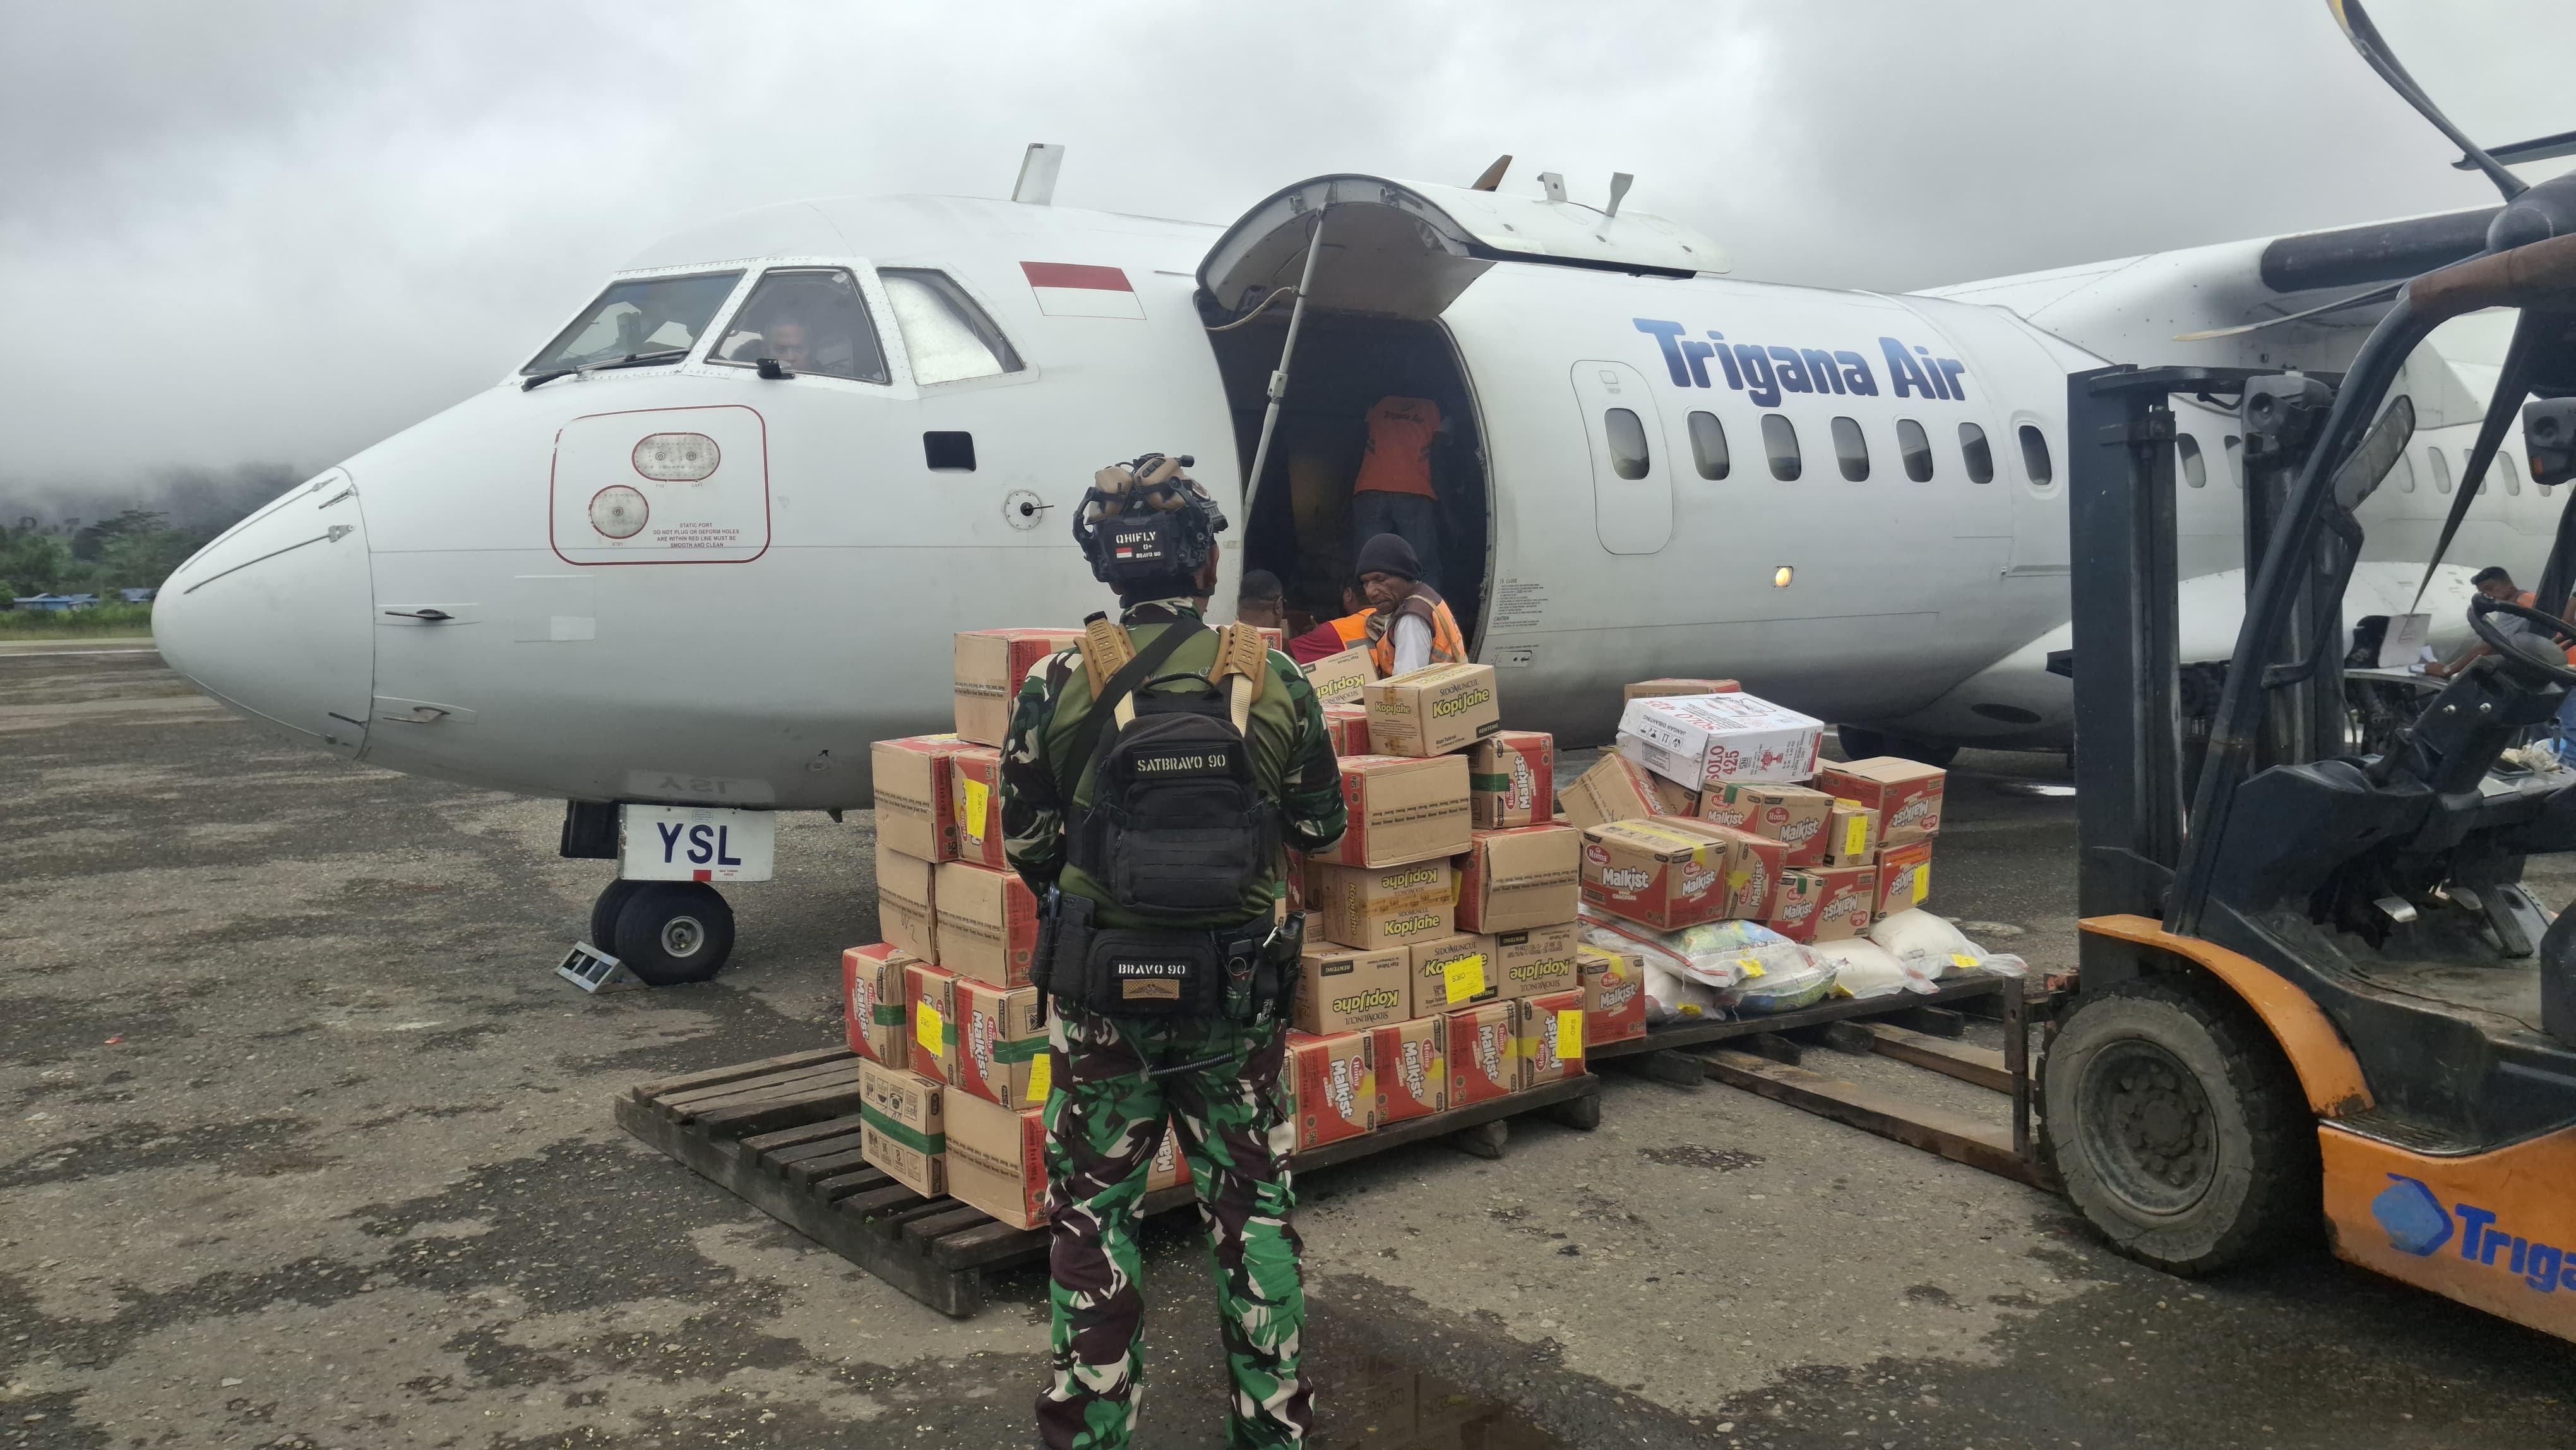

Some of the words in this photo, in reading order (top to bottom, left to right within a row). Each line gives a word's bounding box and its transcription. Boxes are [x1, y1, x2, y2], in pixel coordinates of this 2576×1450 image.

[1633, 318, 1879, 407] Trigana
[1878, 337, 1965, 401] Air
[1478, 723, 1499, 734] RENTENG
[1642, 714, 1667, 728] DIBANTING
[1667, 725, 1686, 736] JANGAN
[1137, 756, 1202, 772] SATBRAVO
[1208, 754, 1225, 768] 90
[1722, 750, 1739, 775] 425
[1514, 755, 1530, 810] Malkist
[1707, 809, 1744, 826] Malkist
[1892, 798, 1929, 827] Malkist
[1779, 817, 1819, 842] Malkist
[657, 822, 741, 865] YSL
[1589, 848, 1607, 863] Roma
[1602, 866, 1650, 891] Malkist
[1686, 865, 1700, 873] Roma
[1682, 870, 1716, 896] Malkist
[1750, 860, 1765, 907] Malkist
[1782, 900, 1813, 920] Malkist
[1822, 892, 1859, 922] Malkist
[1118, 963, 1163, 974] BRAVO
[1167, 964, 1186, 974] 90
[1325, 964, 1351, 973] RENTENG
[856, 977, 870, 1040] Malkist
[1599, 982, 1637, 1010] Malkist
[973, 1010, 989, 1081] Malkist
[1479, 1024, 1500, 1081] Malkist
[1403, 1041, 1425, 1099] Malkist
[1331, 1059, 1354, 1119] Malkist
